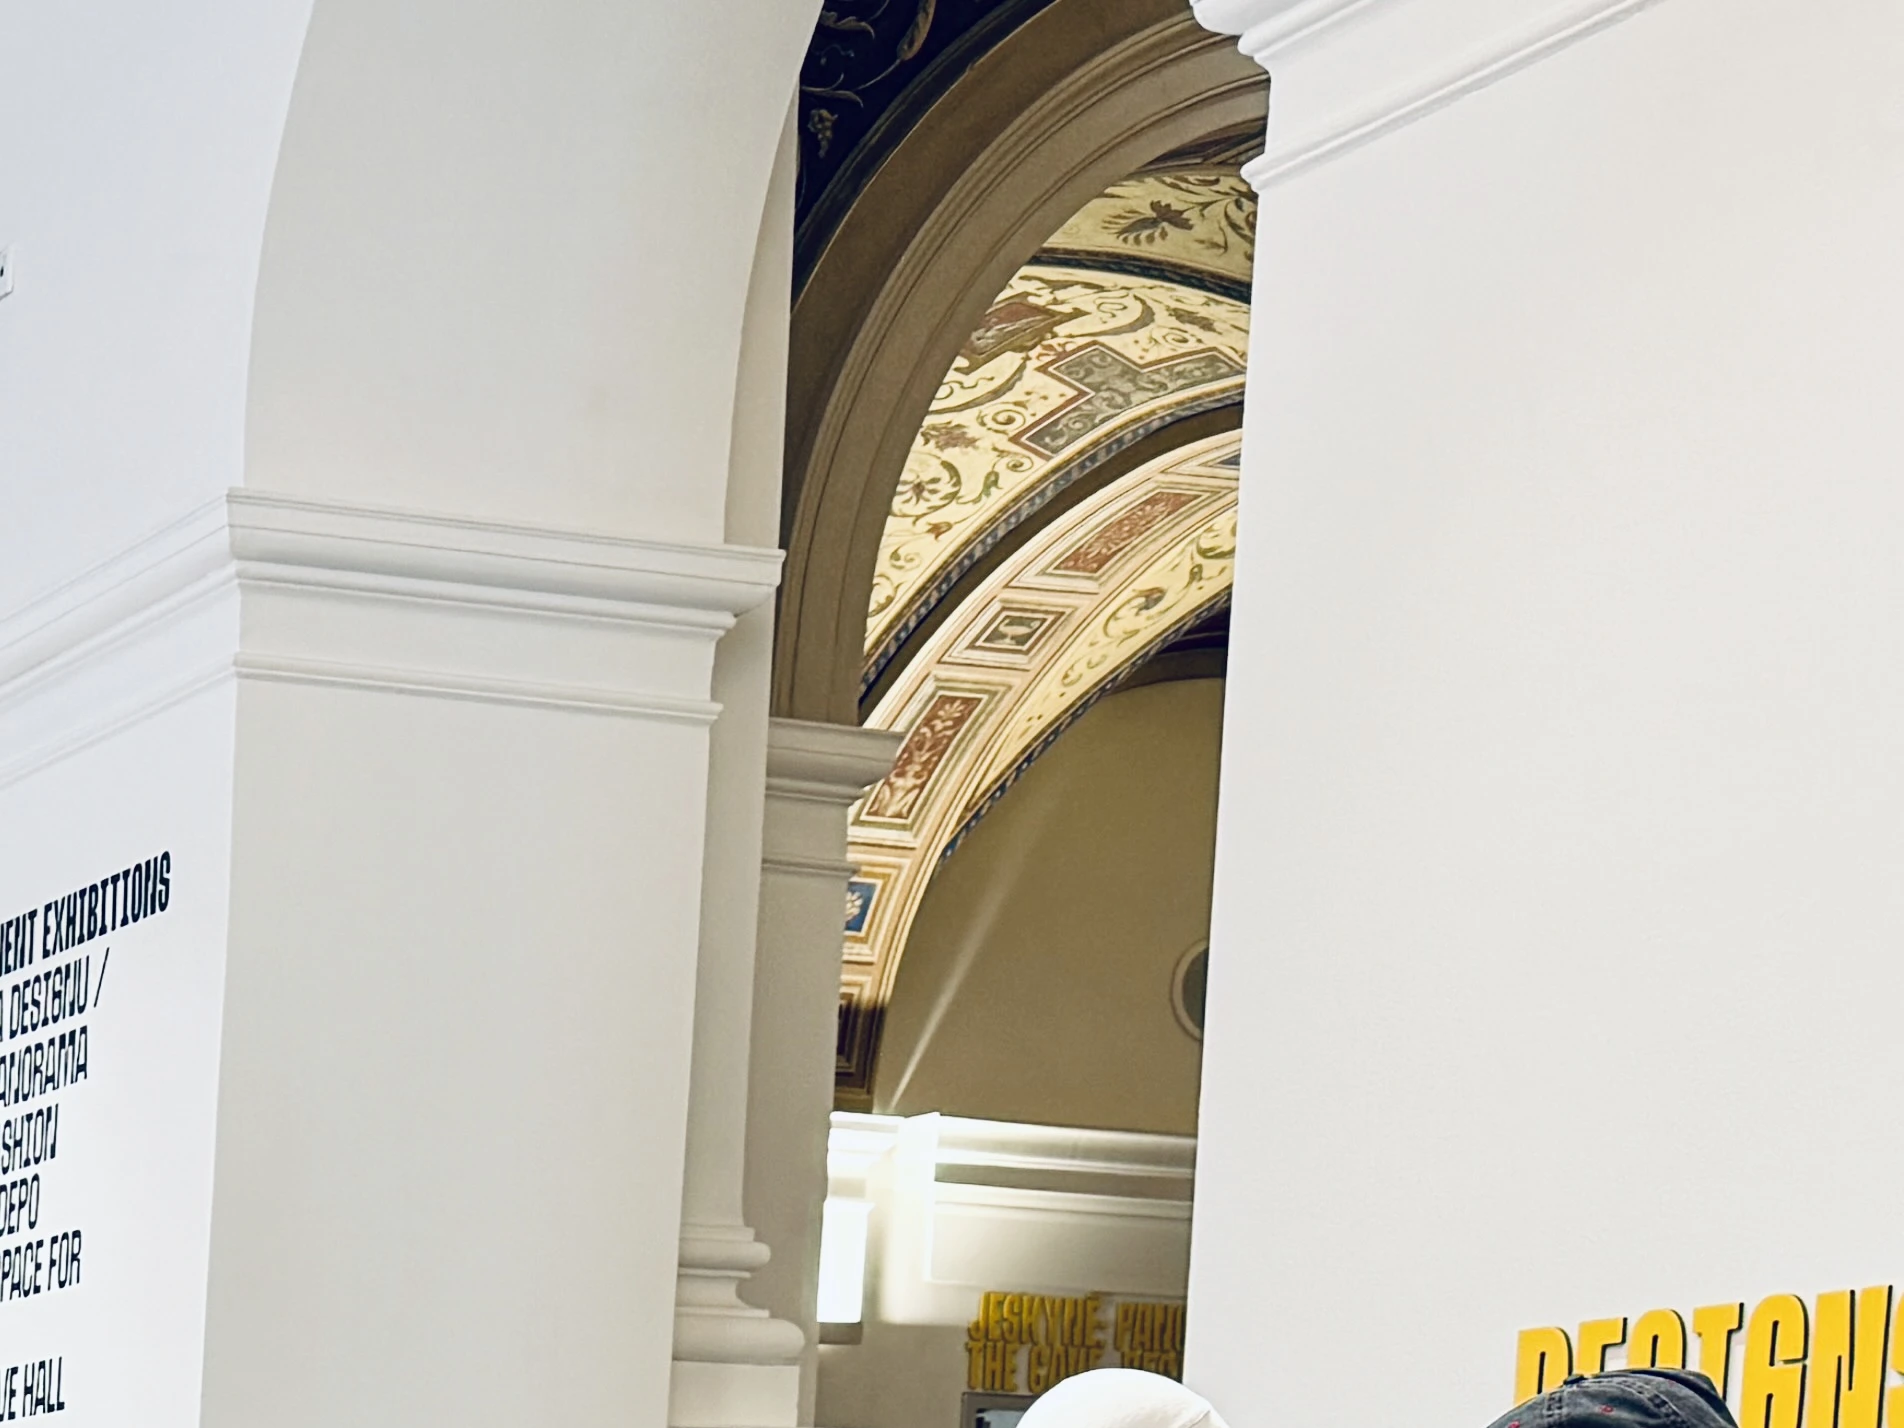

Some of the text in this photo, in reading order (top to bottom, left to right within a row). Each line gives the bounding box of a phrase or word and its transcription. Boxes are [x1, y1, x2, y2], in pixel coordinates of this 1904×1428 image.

[42, 851, 171, 960] EXHIBITIONS
[9, 955, 90, 1040] DESIGNU
[94, 947, 110, 1008] /
[47, 1229, 82, 1291] FOR
[22, 1356, 65, 1418] HALL
